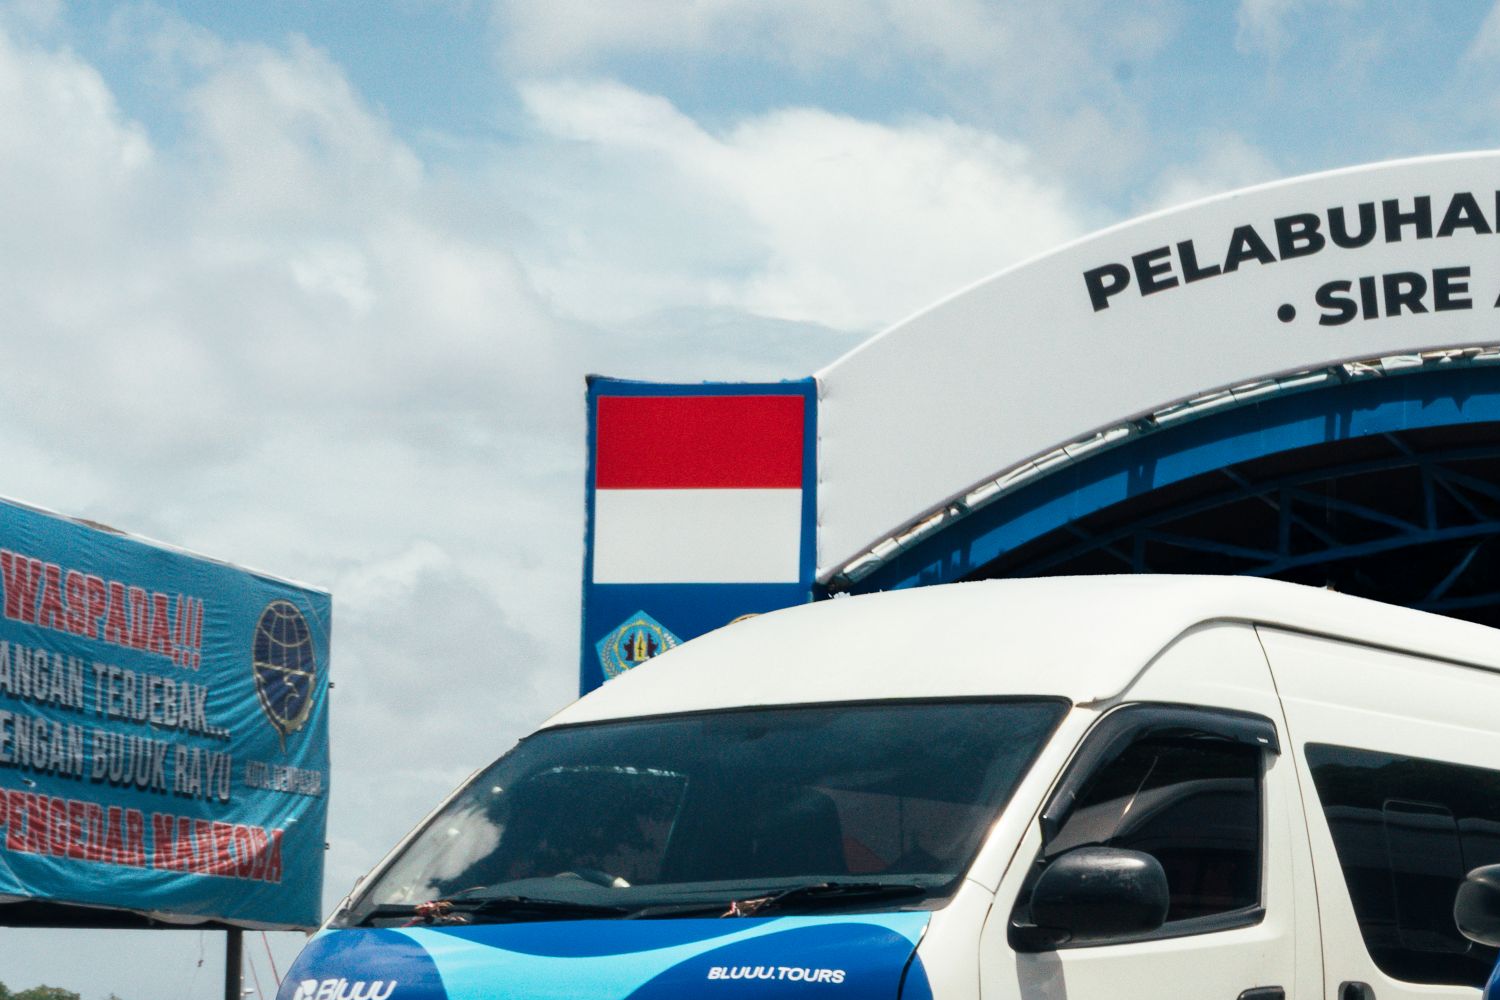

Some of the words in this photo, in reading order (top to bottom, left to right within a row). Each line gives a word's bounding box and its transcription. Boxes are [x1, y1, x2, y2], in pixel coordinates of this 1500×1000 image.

[1314, 265, 1473, 327] SIRE
[1, 549, 203, 670] WASPADA!!!
[93, 731, 165, 790] BUJUK
[175, 744, 231, 801] RAYU
[153, 812, 283, 884] NARKOBA
[707, 966, 846, 984] BLUUU.TOURS
